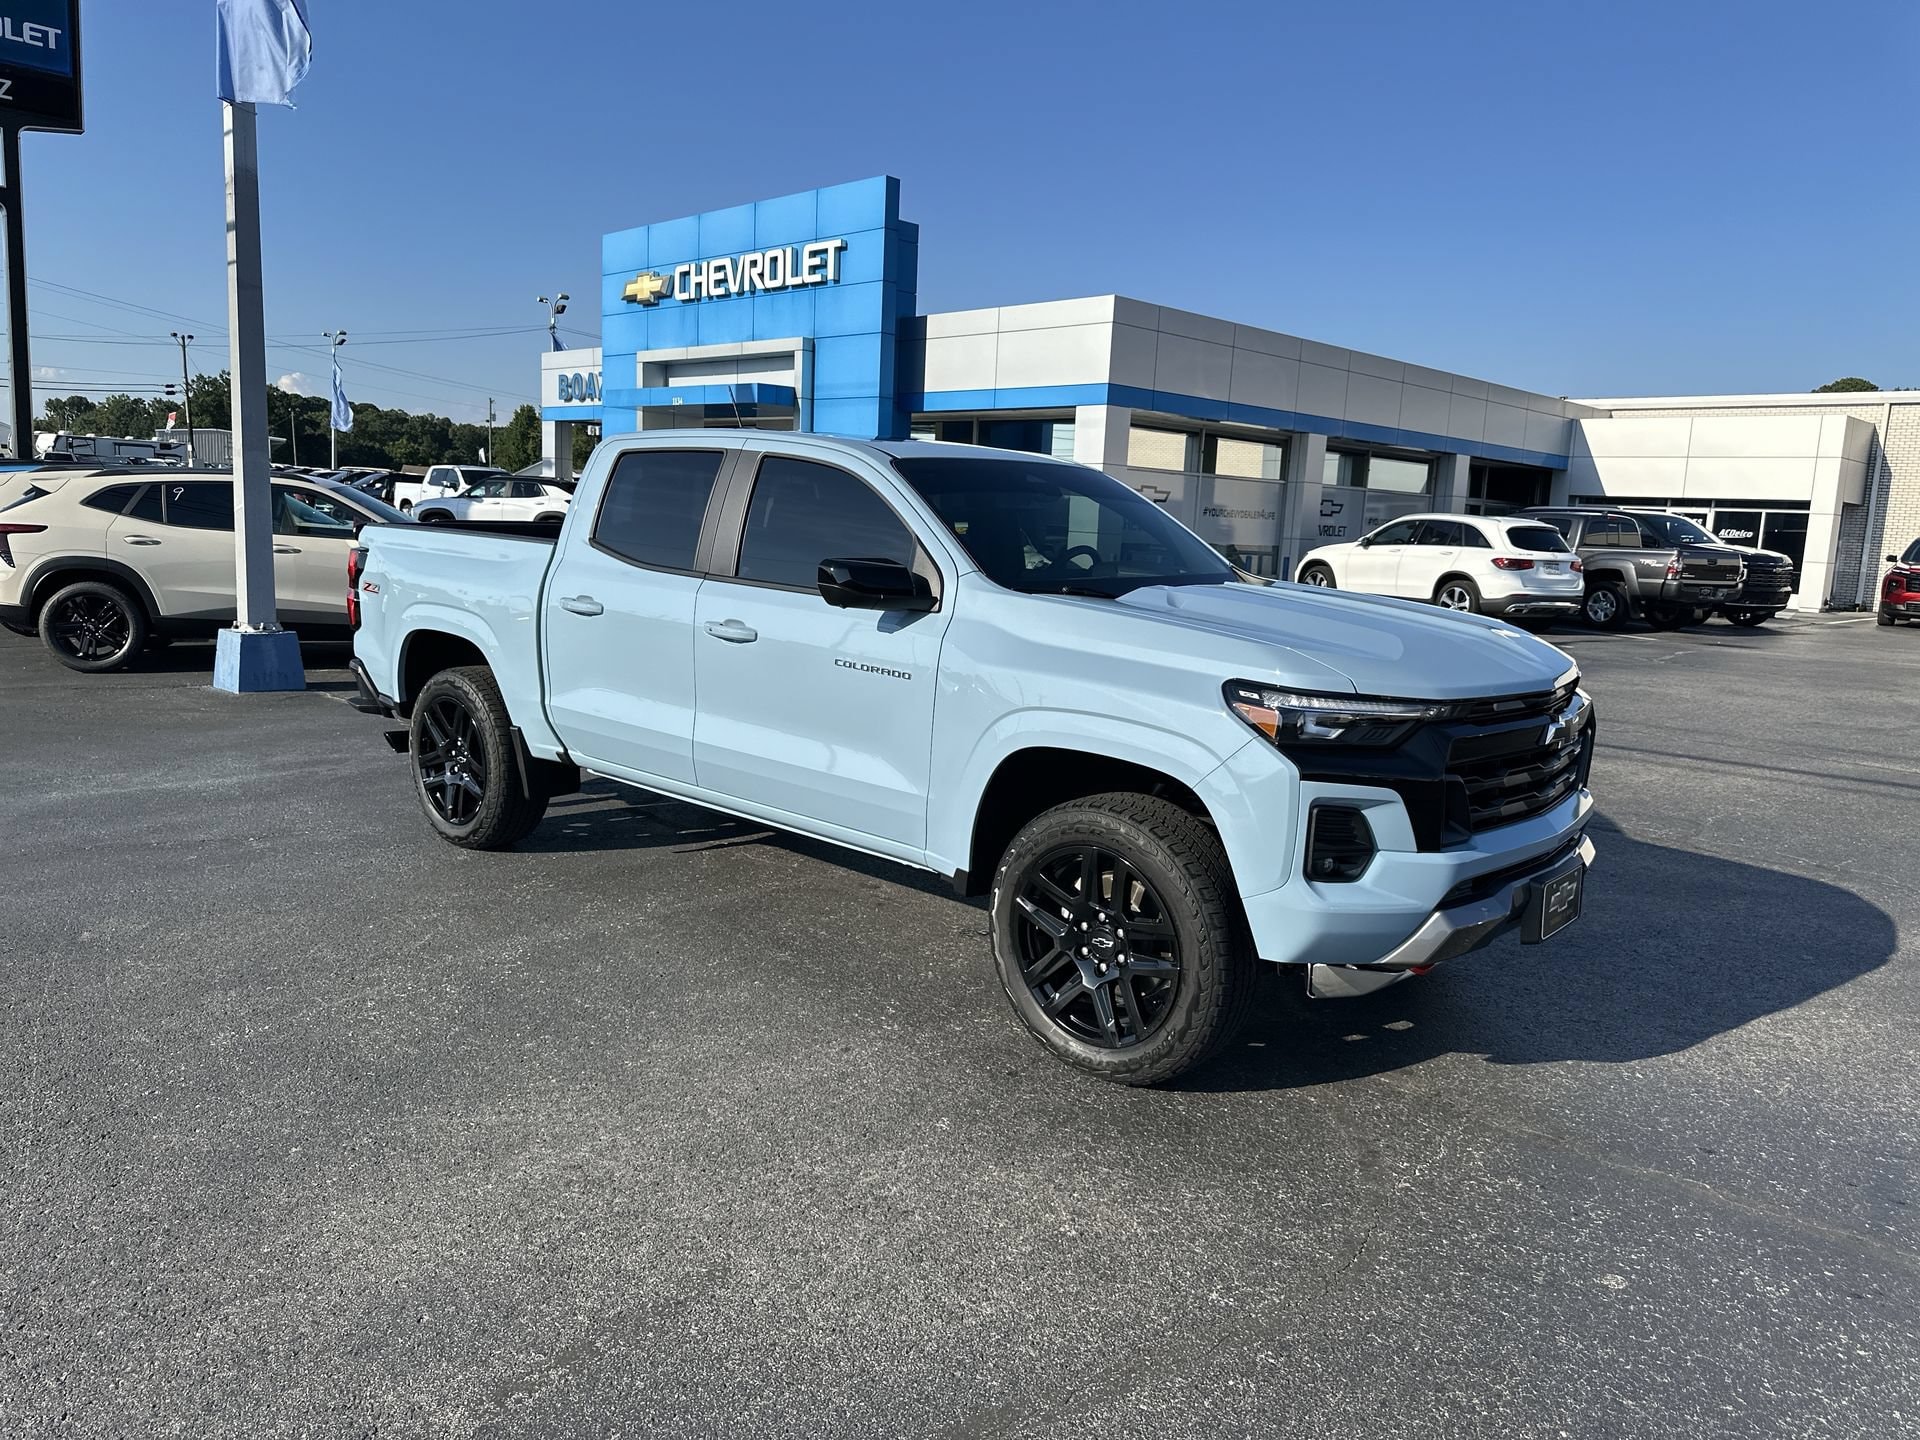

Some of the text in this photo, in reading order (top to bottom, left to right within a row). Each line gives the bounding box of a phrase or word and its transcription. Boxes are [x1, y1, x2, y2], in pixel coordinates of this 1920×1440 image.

[0, 16, 62, 50] LET
[673, 238, 845, 301] CHEVROLET
[558, 371, 602, 403] BOA
[1718, 528, 1754, 539] ACDelco
[834, 658, 913, 681] COLORADO
